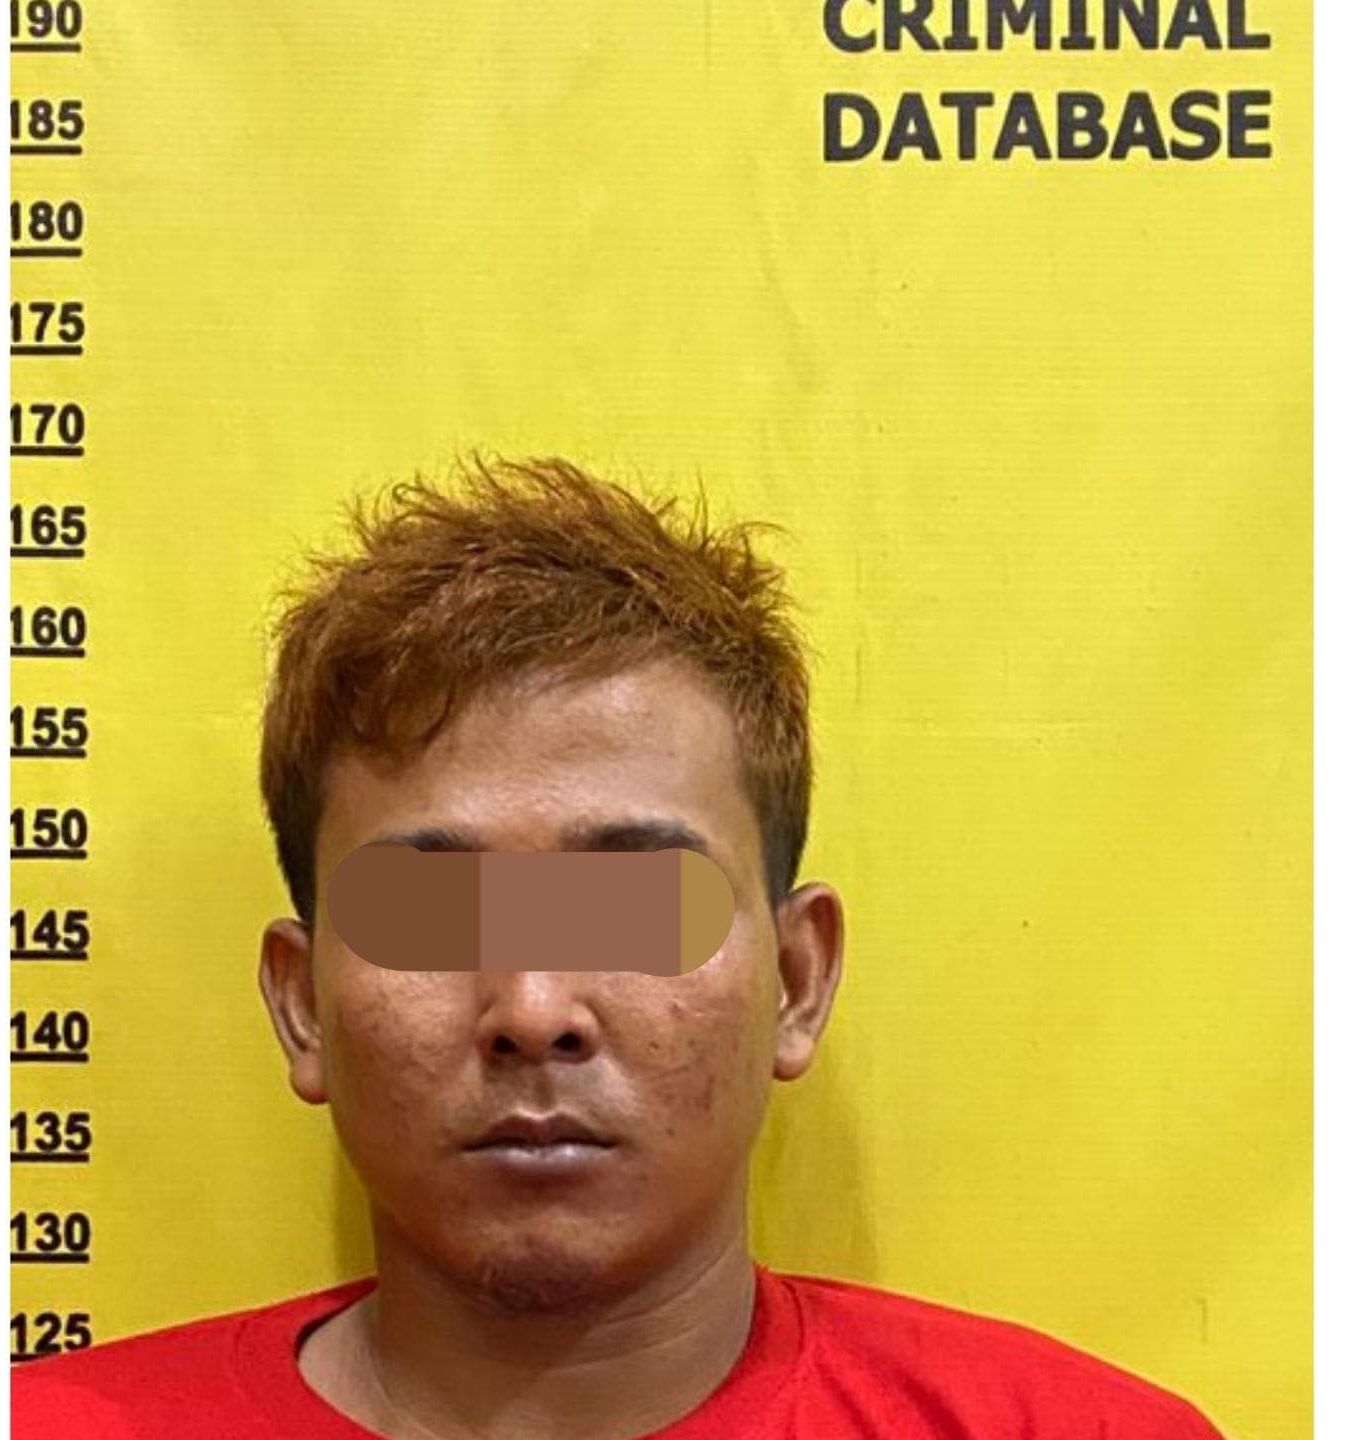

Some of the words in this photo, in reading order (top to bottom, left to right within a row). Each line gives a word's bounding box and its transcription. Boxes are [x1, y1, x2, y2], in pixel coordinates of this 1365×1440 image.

[11, 0, 81, 37] 190
[823, 0, 1272, 53] CRIMINAL
[11, 101, 83, 140] 185
[823, 90, 1272, 161] DATABASE
[11, 202, 82, 240] 180
[10, 303, 84, 342] 175
[10, 404, 84, 444] 170
[10, 506, 86, 545] 165
[10, 607, 85, 648] 160
[10, 707, 87, 749] 155
[10, 809, 87, 850] 150
[10, 910, 89, 951] 145
[10, 1011, 88, 1052] 140
[10, 1112, 91, 1153] 135
[10, 1213, 90, 1253] 130
[10, 1313, 91, 1352] 125
